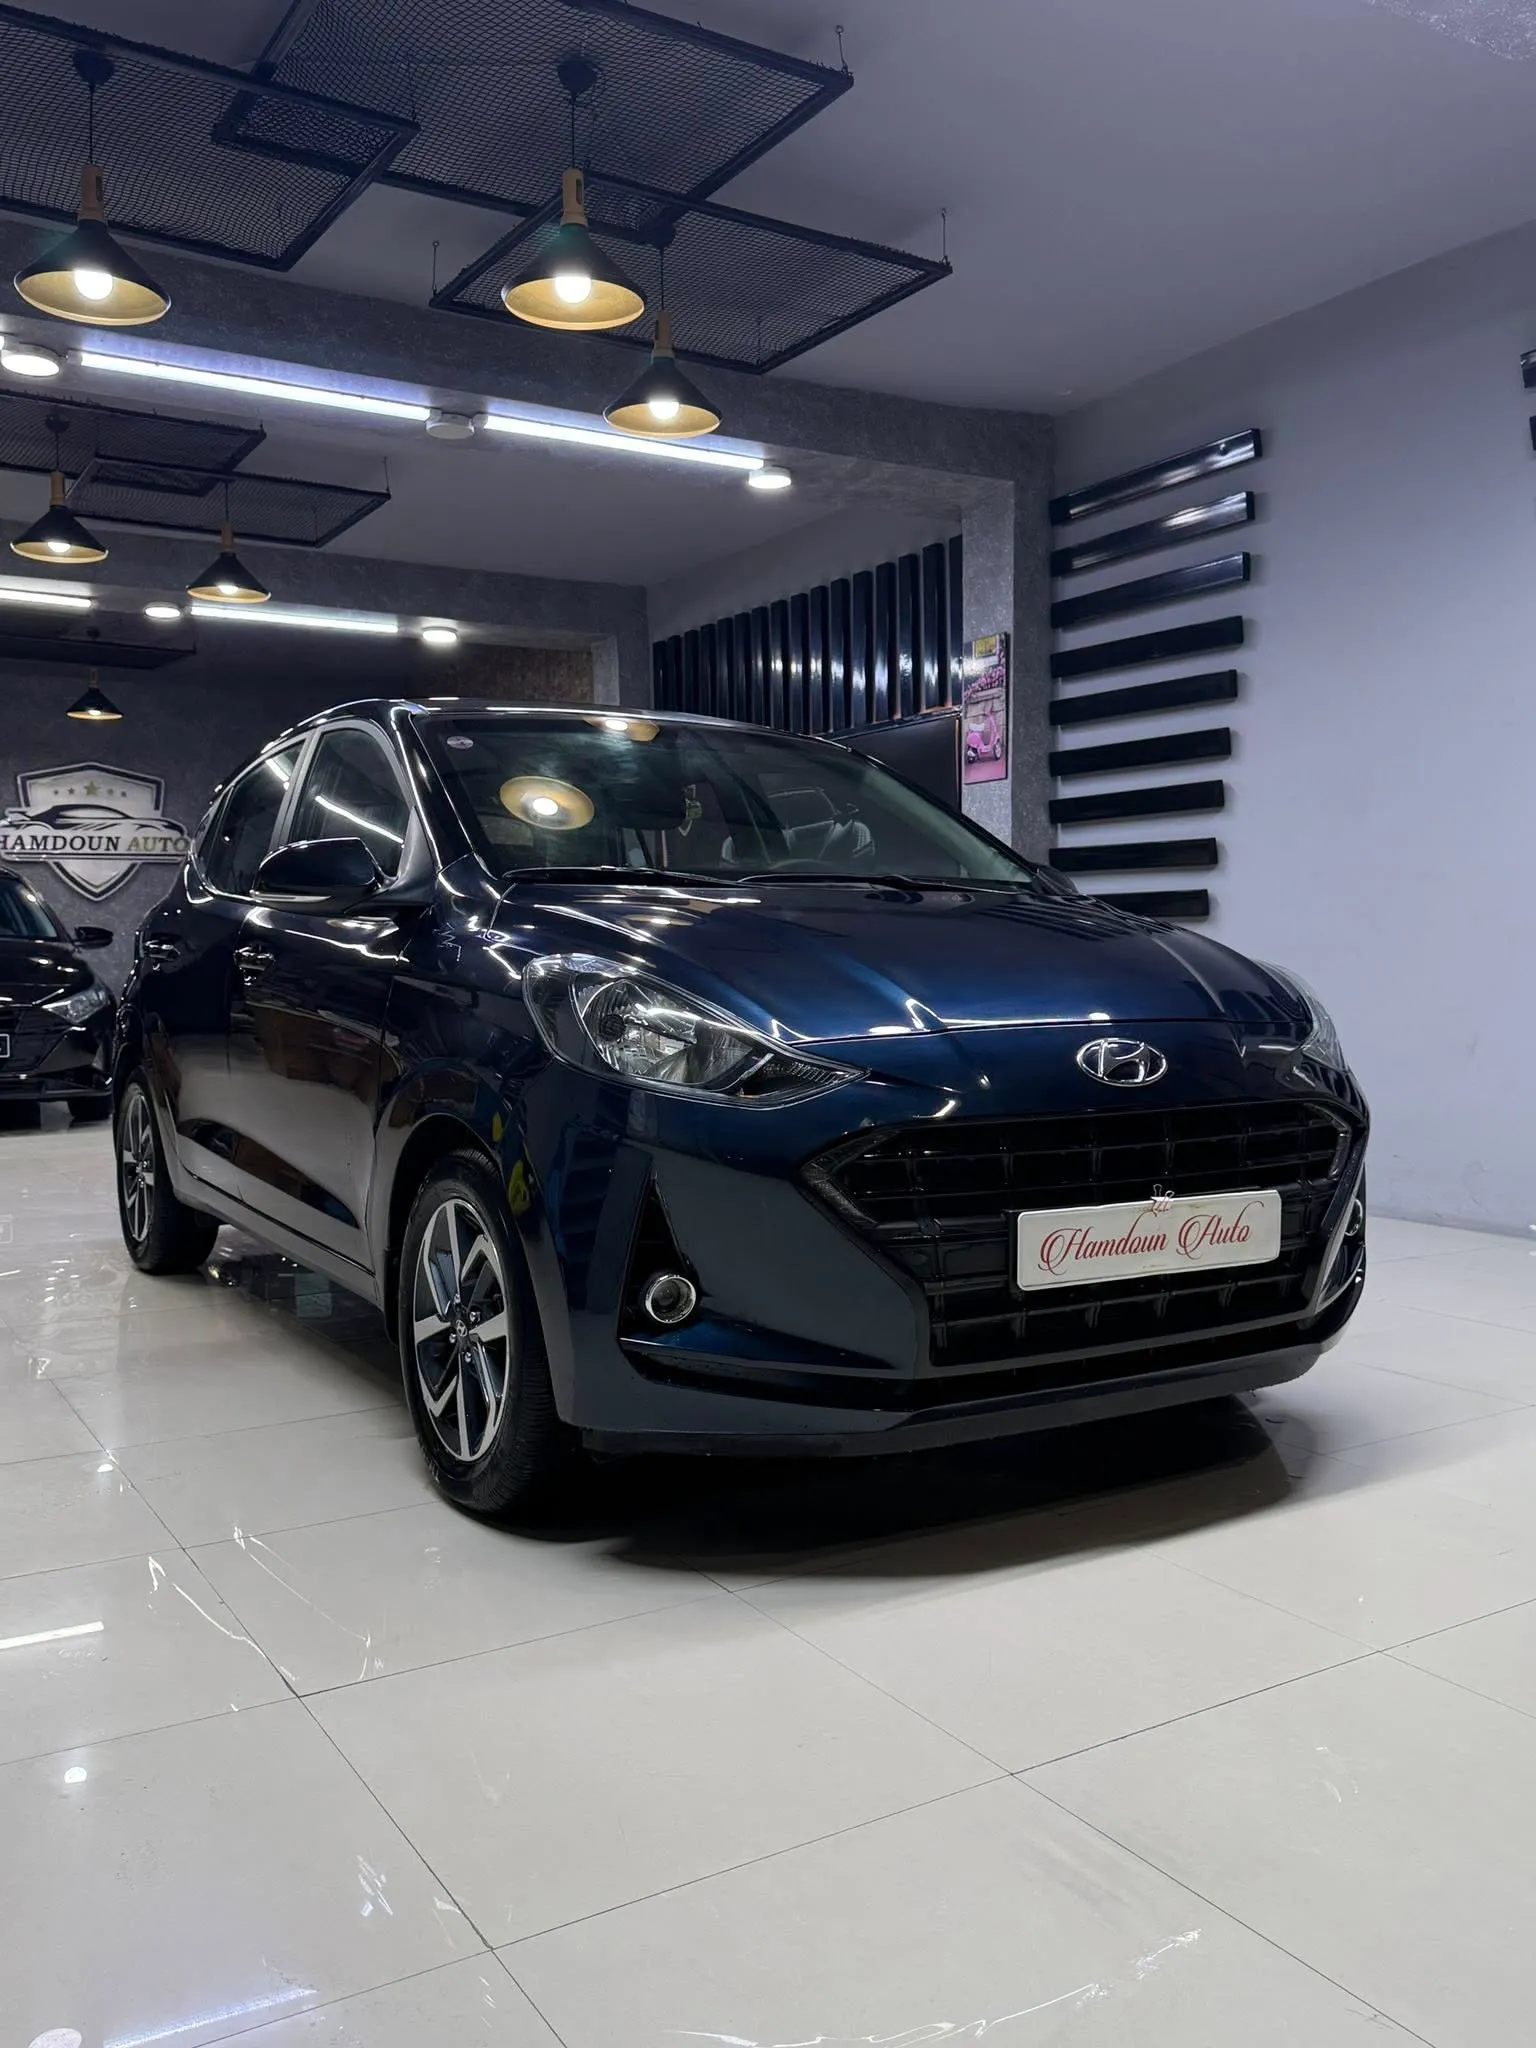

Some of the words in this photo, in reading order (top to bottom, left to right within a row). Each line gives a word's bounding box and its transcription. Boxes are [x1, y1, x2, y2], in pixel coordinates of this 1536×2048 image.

[127, 836, 190, 851] AUTO
[1037, 1209, 1168, 1276] Hamdoun
[1176, 1200, 1265, 1260] Auto
